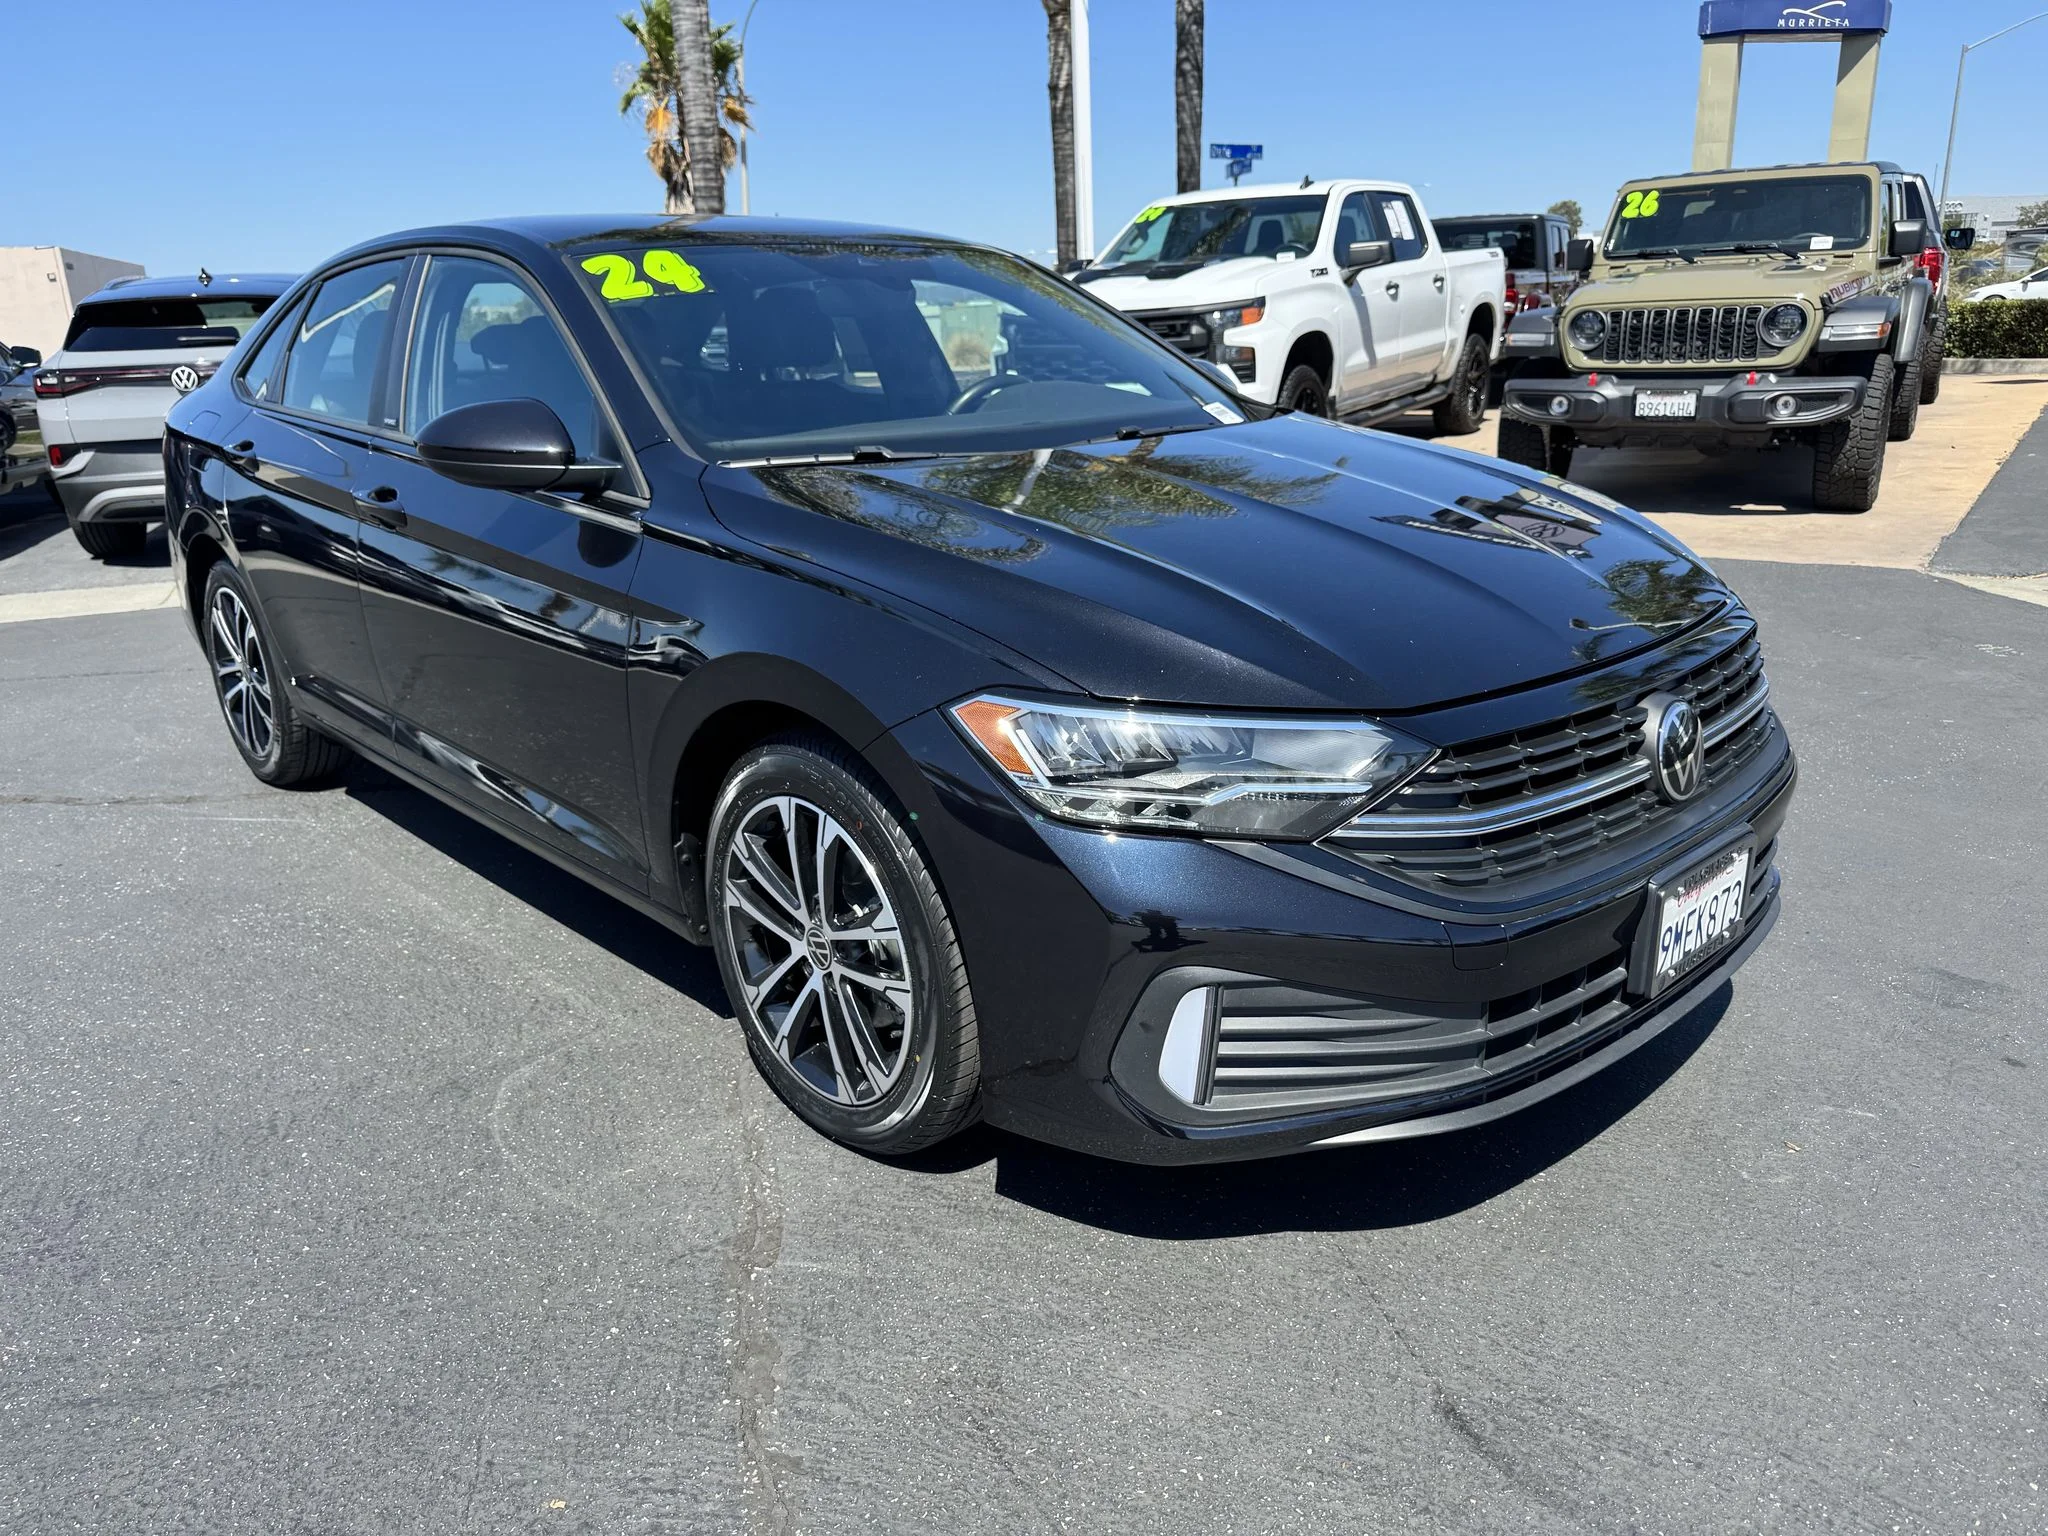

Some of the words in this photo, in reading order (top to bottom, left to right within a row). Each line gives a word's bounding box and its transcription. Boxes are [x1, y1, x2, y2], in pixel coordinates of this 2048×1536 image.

[1777, 18, 1850, 27] MURRIETA
[1622, 190, 1660, 218] 26
[581, 250, 705, 300] 24
[1658, 880, 1742, 975] 9MEK873
